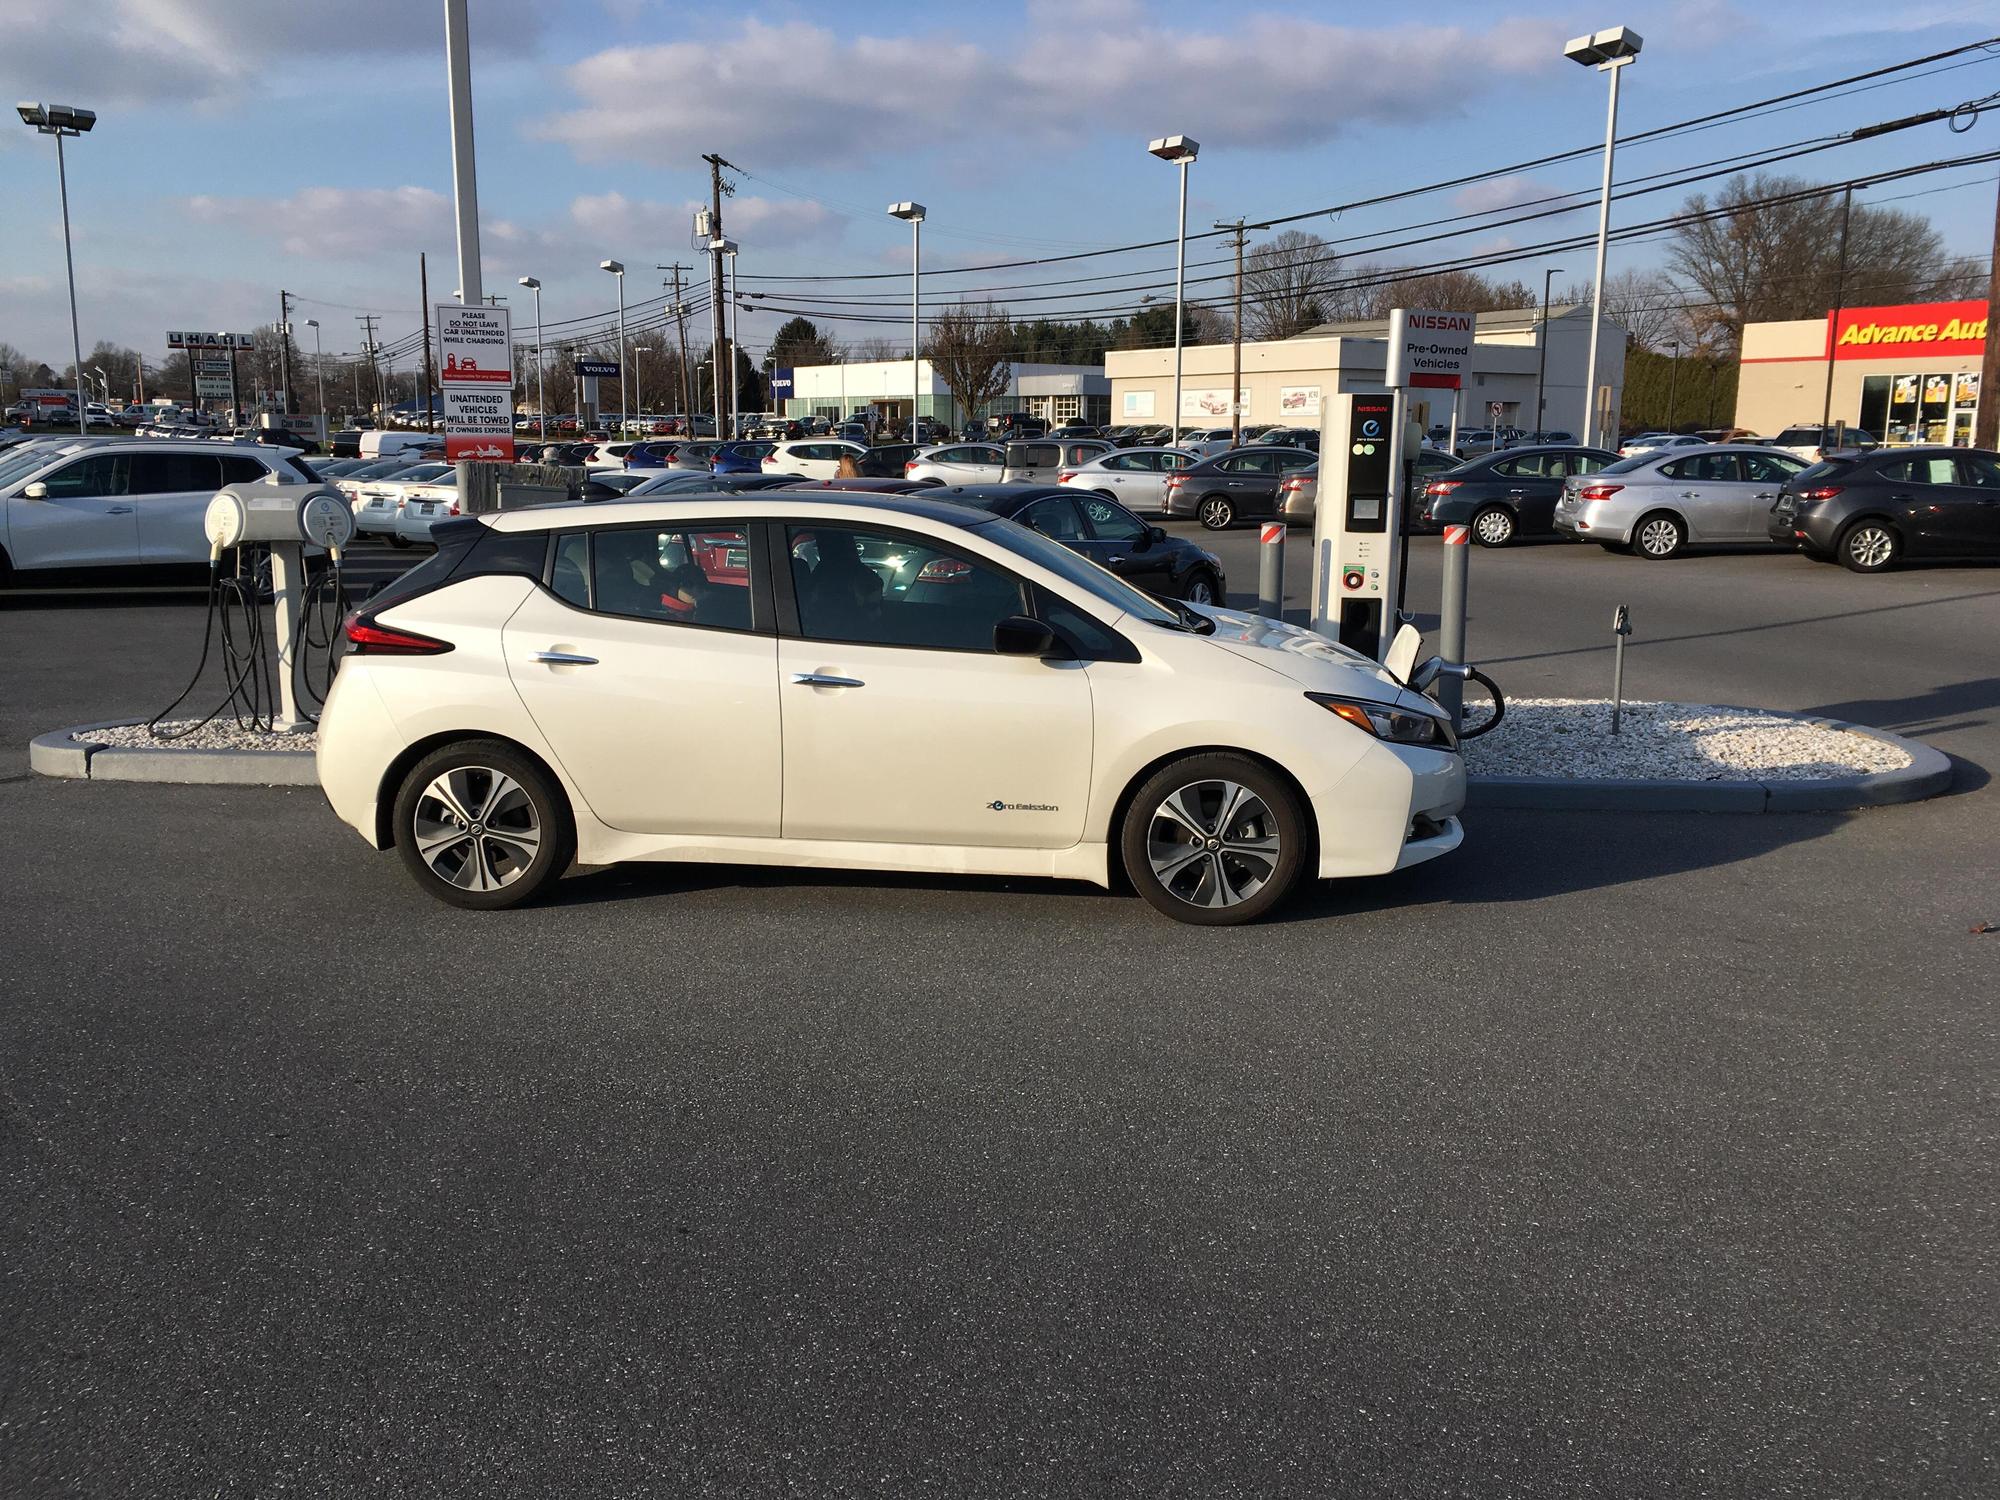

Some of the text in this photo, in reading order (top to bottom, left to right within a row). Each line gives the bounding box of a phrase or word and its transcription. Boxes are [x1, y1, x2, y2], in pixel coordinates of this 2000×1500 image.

[1409, 314, 1470, 331] NISSAN
[1838, 323, 1938, 345] Advance
[1407, 343, 1468, 355] Pre-Owned
[1413, 358, 1460, 369] Vehicles
[450, 394, 503, 404] UNATTENDED
[459, 405, 498, 414] VEHICLES
[446, 415, 510, 424] WILL BE TOWED
[1016, 803, 1059, 811] Emission
